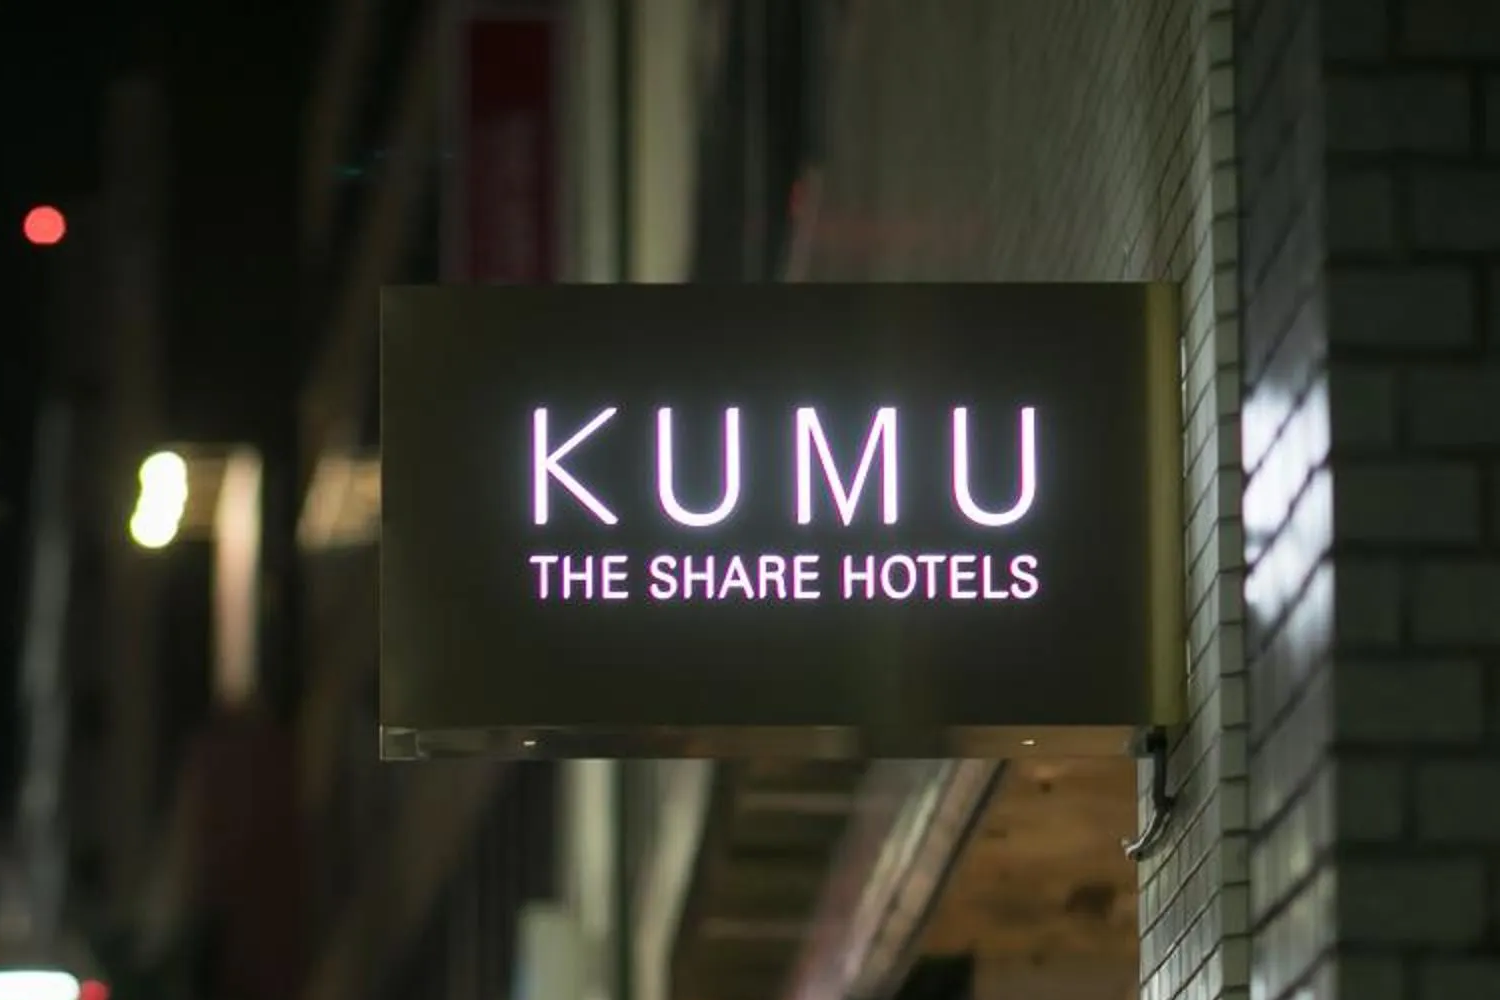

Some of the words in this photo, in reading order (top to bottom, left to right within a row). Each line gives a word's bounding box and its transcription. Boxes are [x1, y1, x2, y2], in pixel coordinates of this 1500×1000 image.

[531, 405, 1038, 528] KUMU
[528, 553, 630, 600] THE
[648, 553, 822, 600] SHARE
[842, 553, 1040, 600] HOTELS
